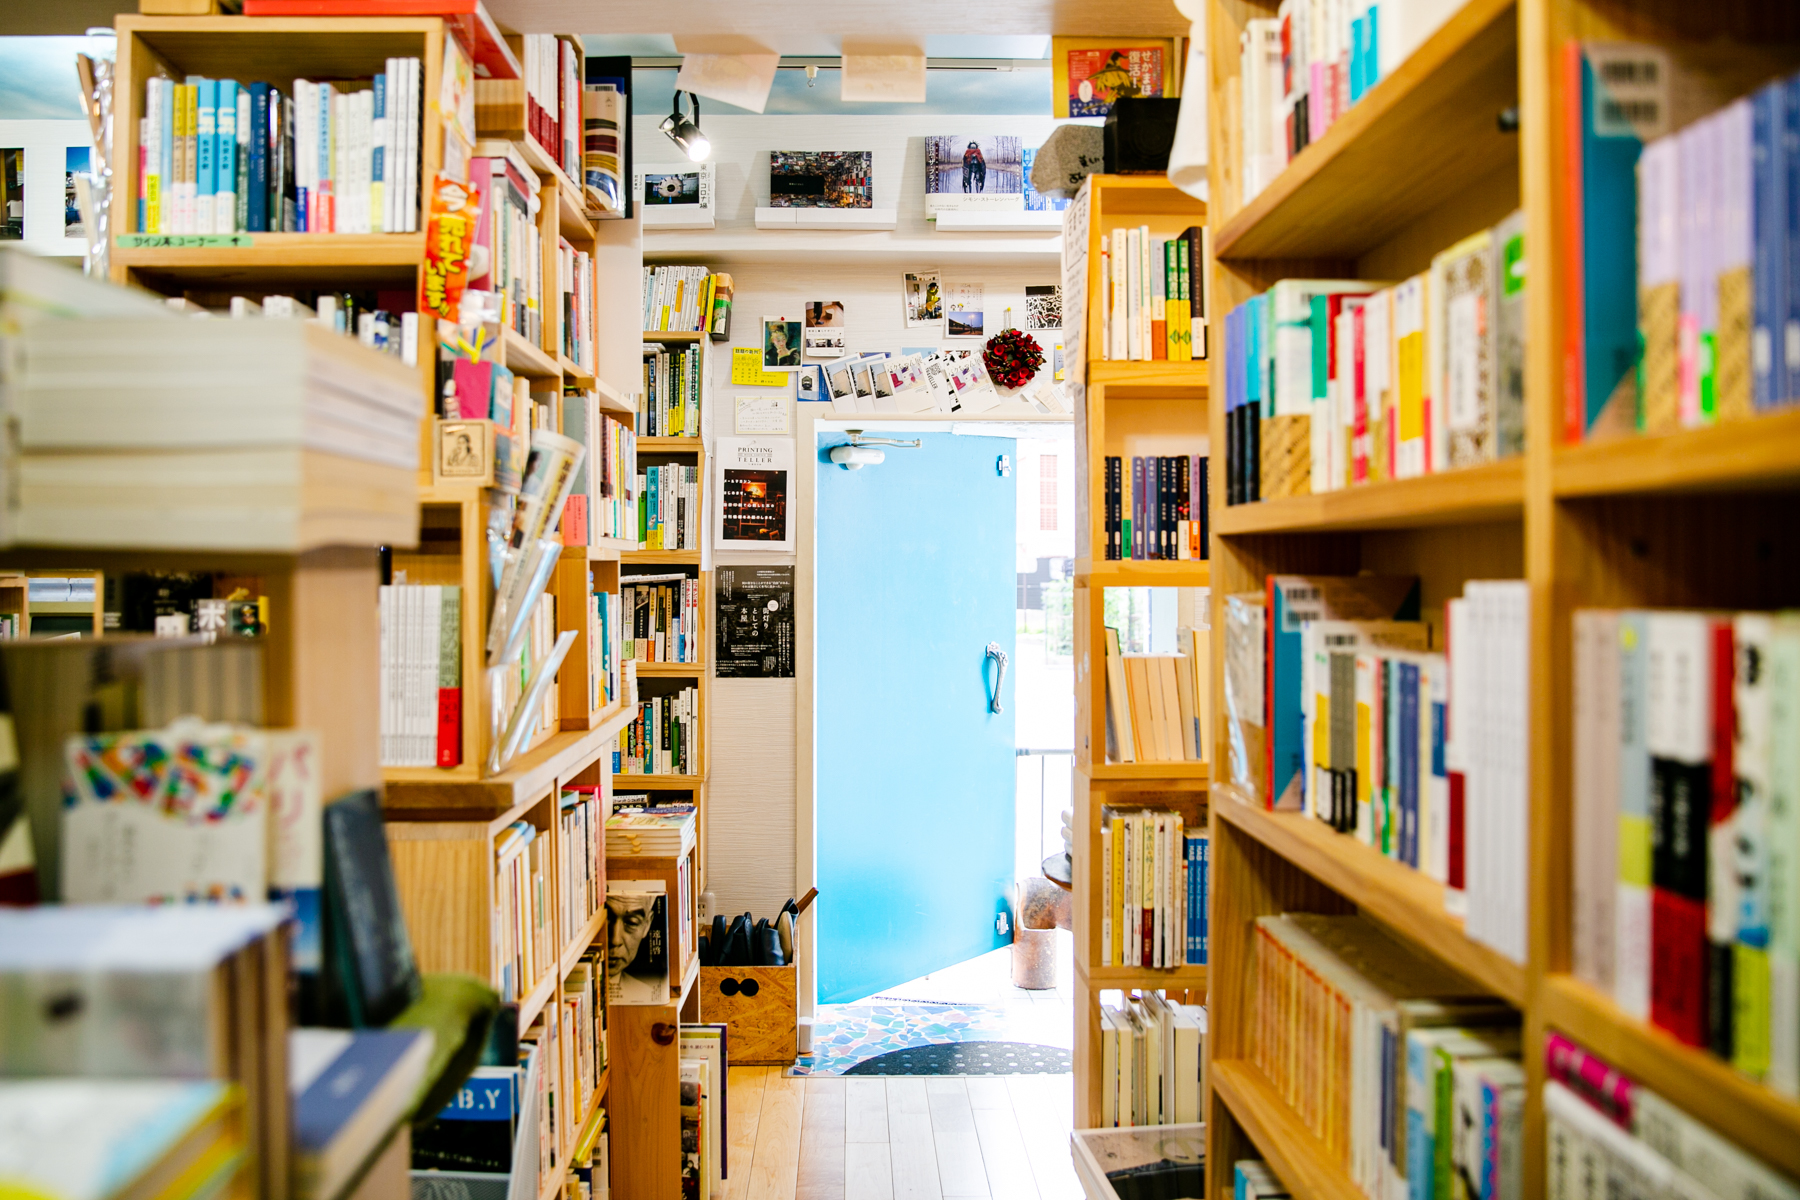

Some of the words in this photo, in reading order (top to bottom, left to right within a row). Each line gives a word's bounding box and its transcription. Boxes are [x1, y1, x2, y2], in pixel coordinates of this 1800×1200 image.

[1141, 50, 1152, 95] せかまほ
[740, 607, 748, 622] 本屋
[762, 607, 770, 629] 街灯り
